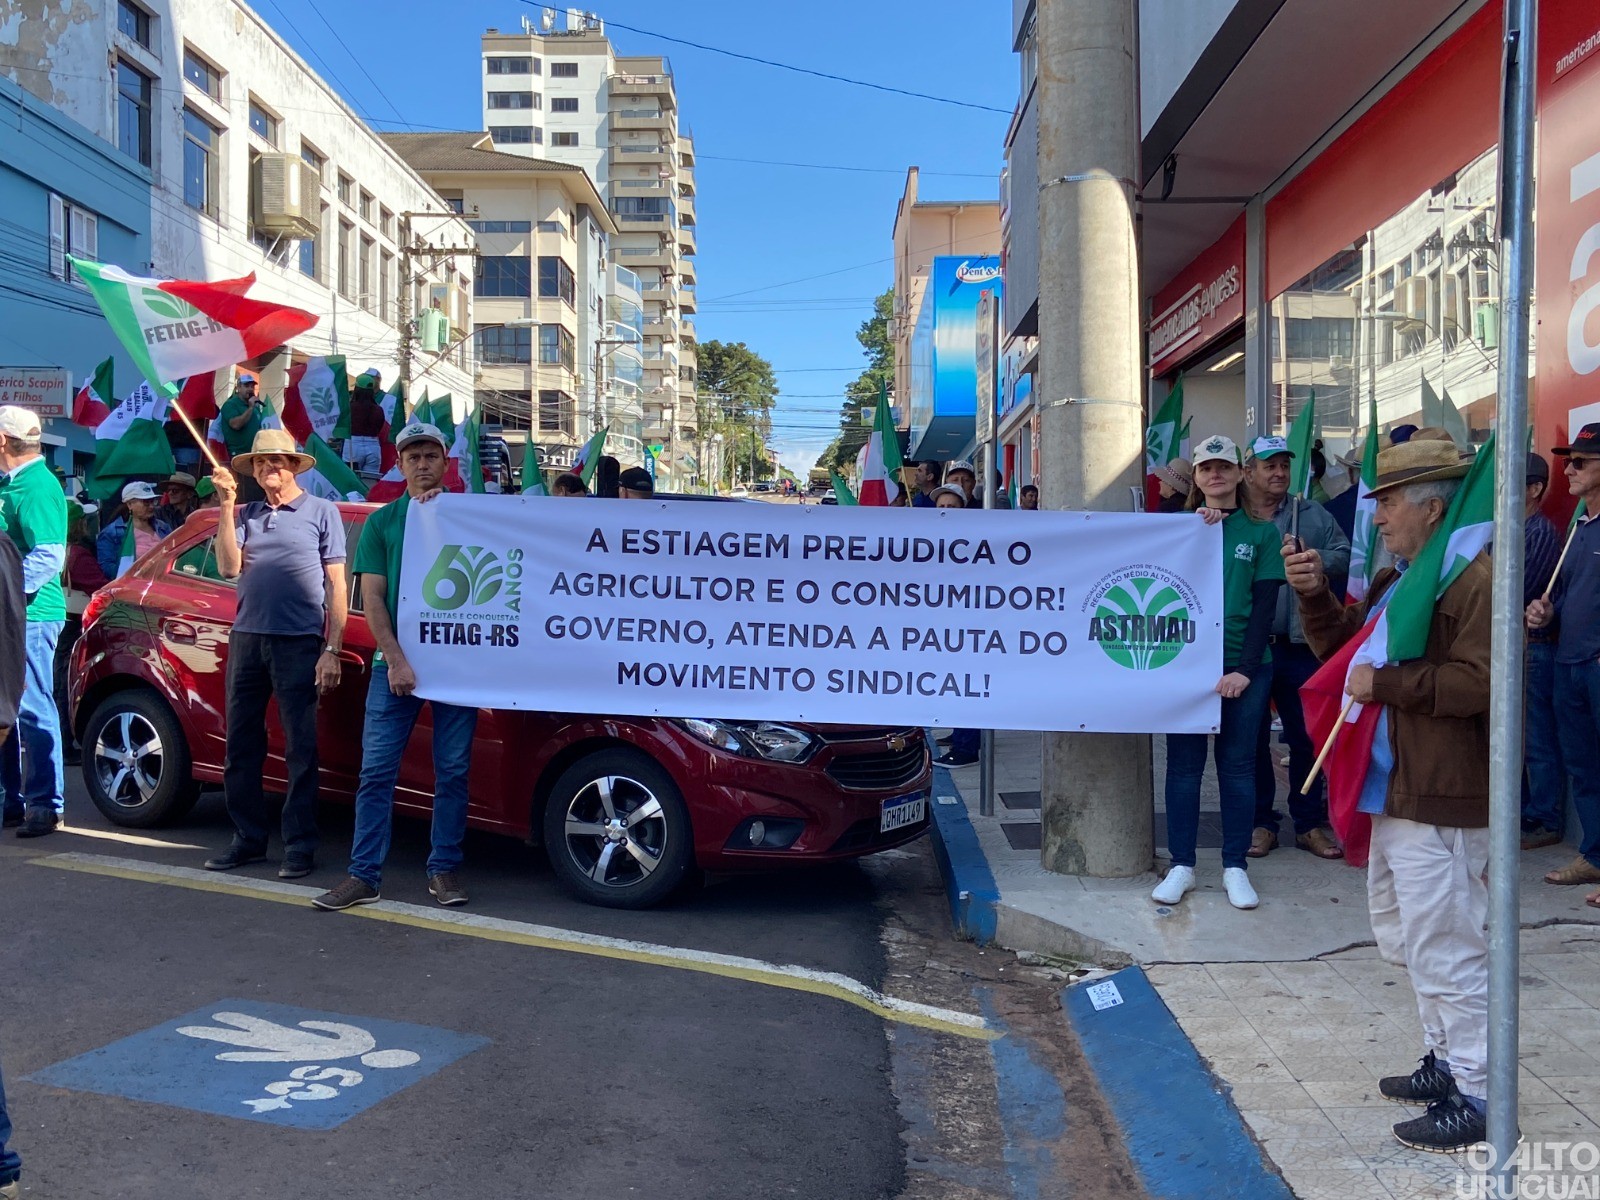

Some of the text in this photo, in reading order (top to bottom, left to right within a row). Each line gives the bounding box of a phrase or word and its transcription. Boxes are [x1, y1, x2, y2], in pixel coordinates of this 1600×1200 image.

[961, 267, 983, 276] Dent
[1201, 264, 1239, 319] express
[2, 391, 43, 402] & Filhos
[28, 376, 64, 391] Scapin
[1246, 406, 1255, 426] 53
[585, 528, 1031, 566] A ESTIAGEM PREJUDICA O
[504, 548, 524, 613] ANOS
[549, 571, 1066, 611] AGRICULTOR E O CONSUMIDOR!
[1090, 570, 1194, 610] REGIÃO DO MÉDIO ALTO URUGUAI
[420, 611, 430, 619] DE
[467, 613, 520, 621] CONQUISTAS
[1088, 614, 1196, 644] ASTRMAU
[545, 615, 1068, 656] GOVERNO, ATENDA A PAUTA DO
[617, 661, 991, 698] MOVIMENTO SINDICAL!
